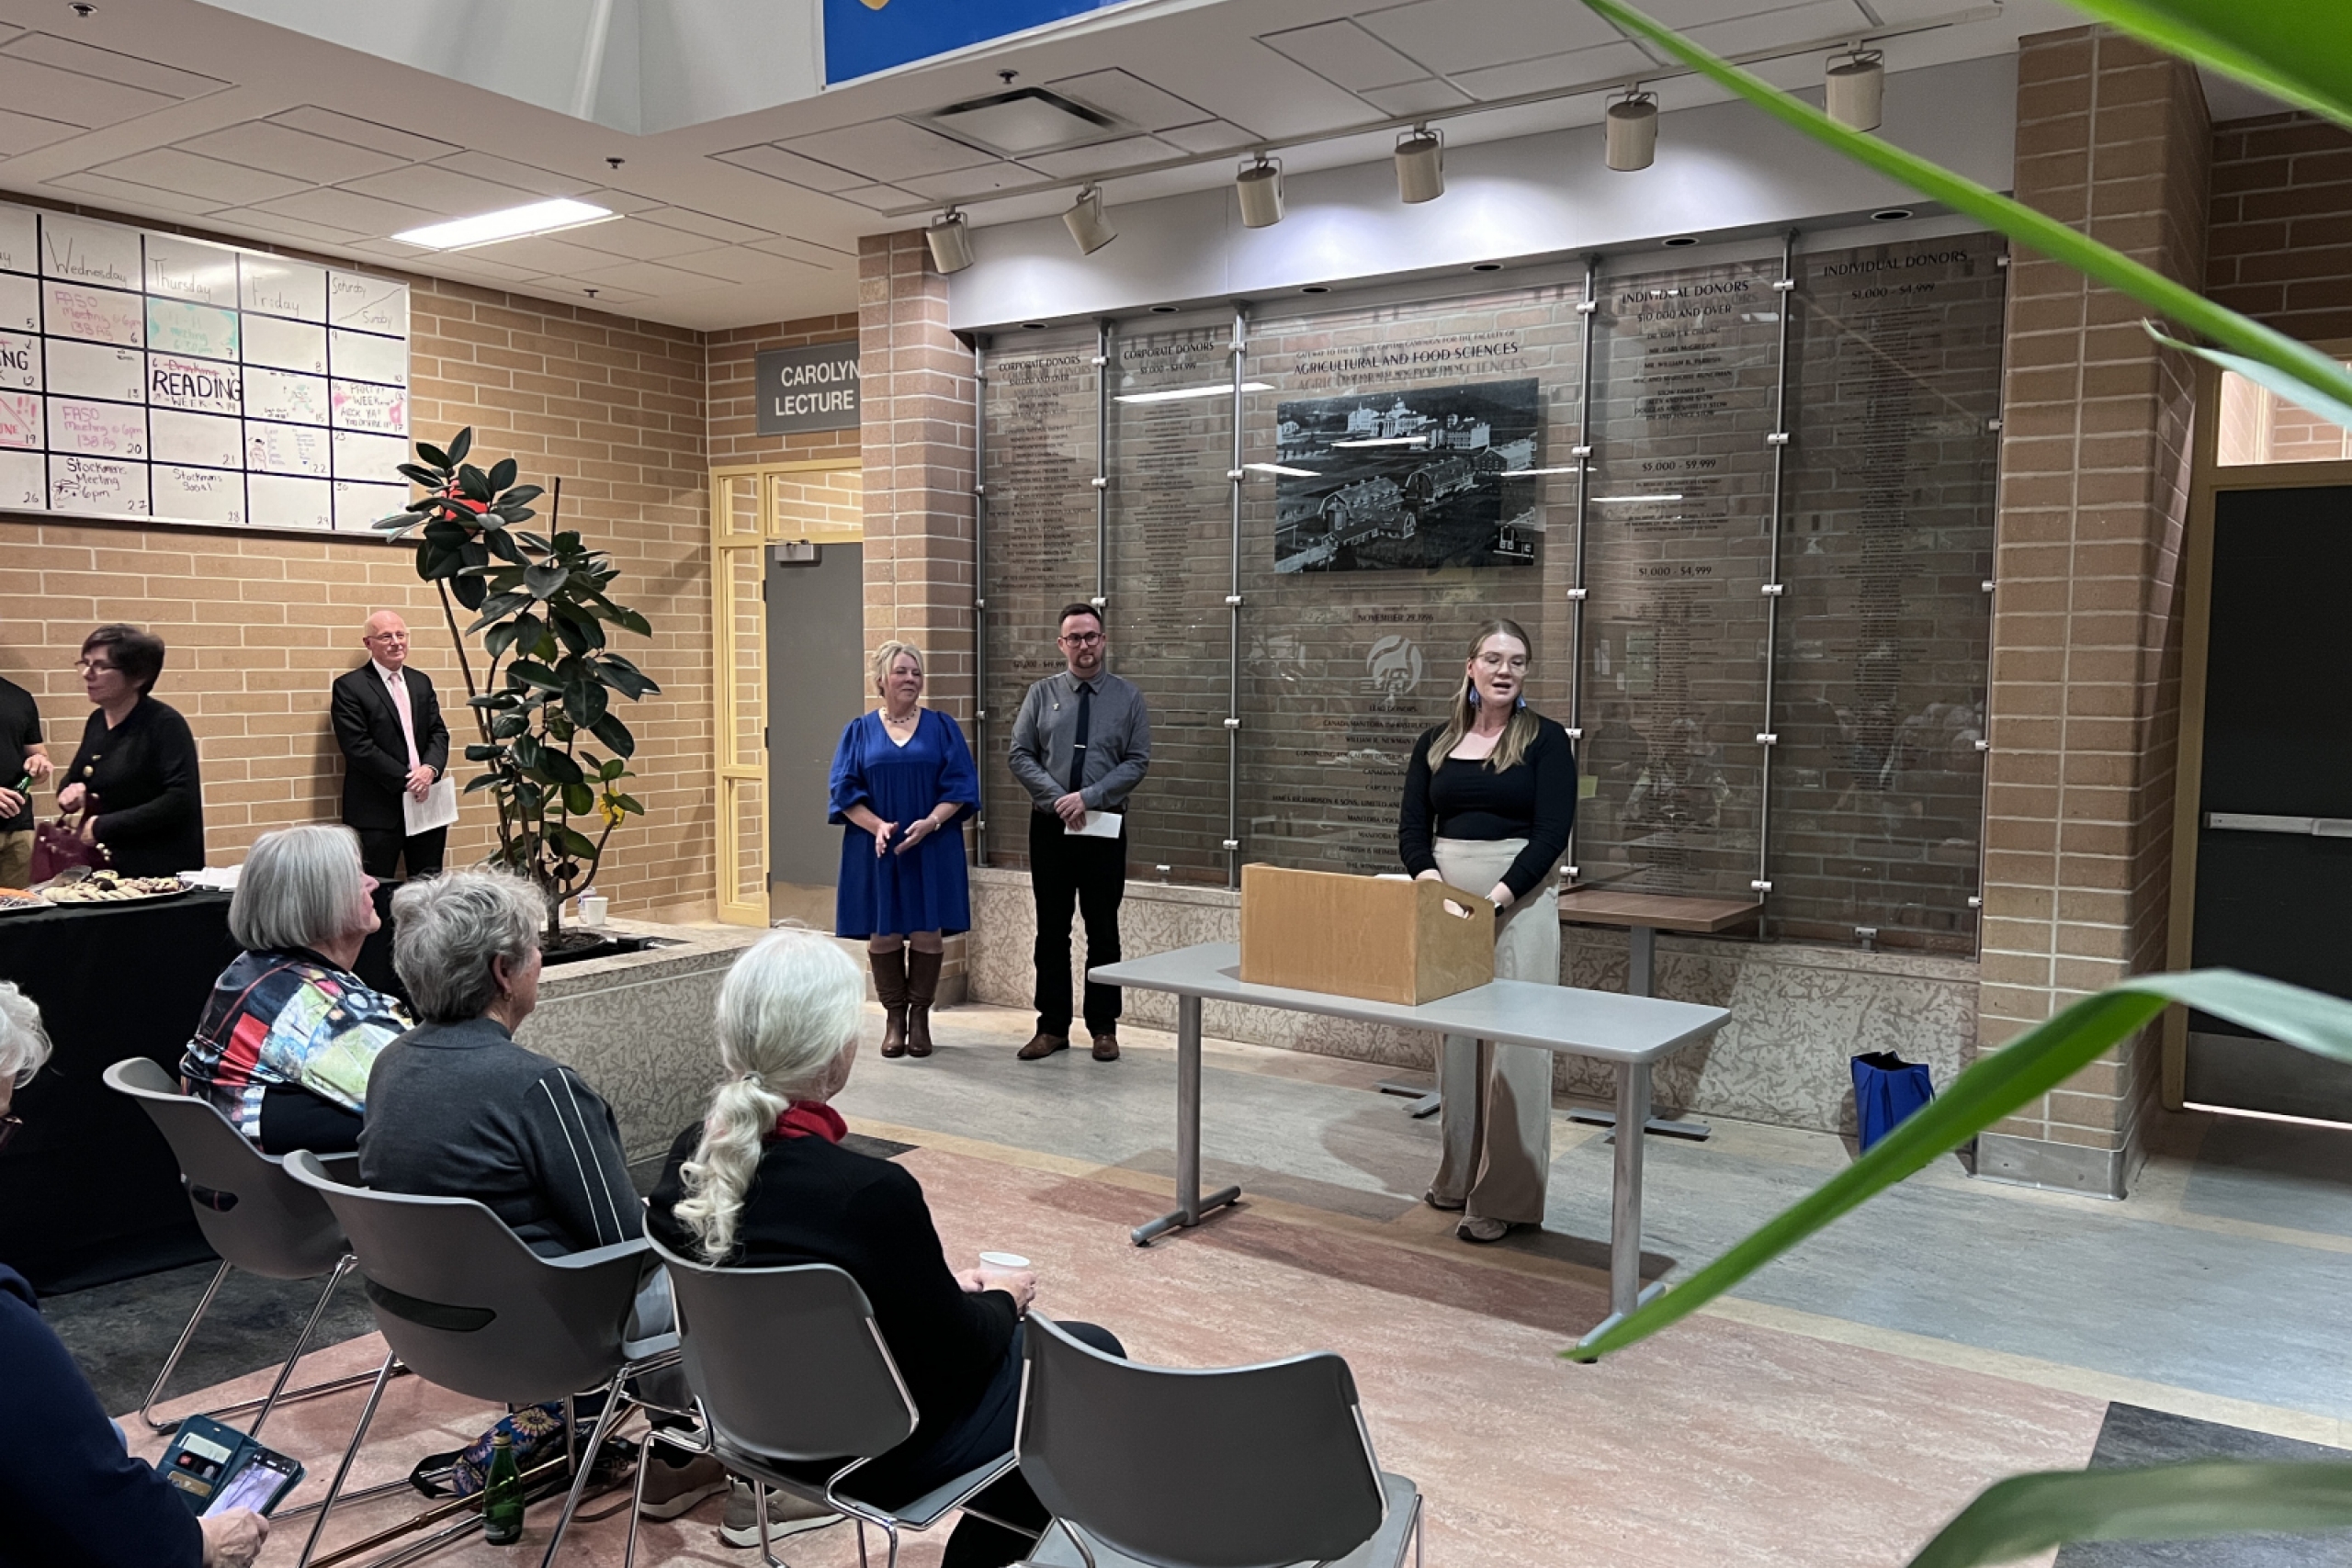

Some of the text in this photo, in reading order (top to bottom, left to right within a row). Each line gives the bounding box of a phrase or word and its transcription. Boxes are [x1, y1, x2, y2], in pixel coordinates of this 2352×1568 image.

[46, 231, 127, 288] Wednesday
[1824, 250, 1968, 276] INDIVIDUAL DONORS
[149, 257, 211, 304] Thursday
[253, 276, 300, 317] Friday
[1623, 280, 1749, 304] INDIVIDUAL DONORS
[1679, 308, 1701, 318] AND
[1703, 304, 1732, 315] OVER
[26, 318, 35, 329] 5
[130, 332, 138, 344] 6
[1124, 341, 1215, 360] CORPORATE DONORS
[1046, 355, 1081, 367] DONORS
[1294, 341, 1518, 376] AGRICULTURAL AND FOOD SCIENCES
[315, 361, 322, 372] 8
[781, 359, 860, 387] CAROLYN
[153, 370, 242, 401] READING
[127, 389, 140, 399] 13
[775, 389, 854, 416] LECTURE
[26, 434, 36, 445] 19
[127, 444, 141, 455] 20
[222, 454, 236, 466] 21
[313, 464, 327, 473] 22
[76, 475, 120, 491] Meeting
[23, 491, 40, 504] 26
[82, 488, 110, 502] 6pm
[317, 515, 330, 525] 29
